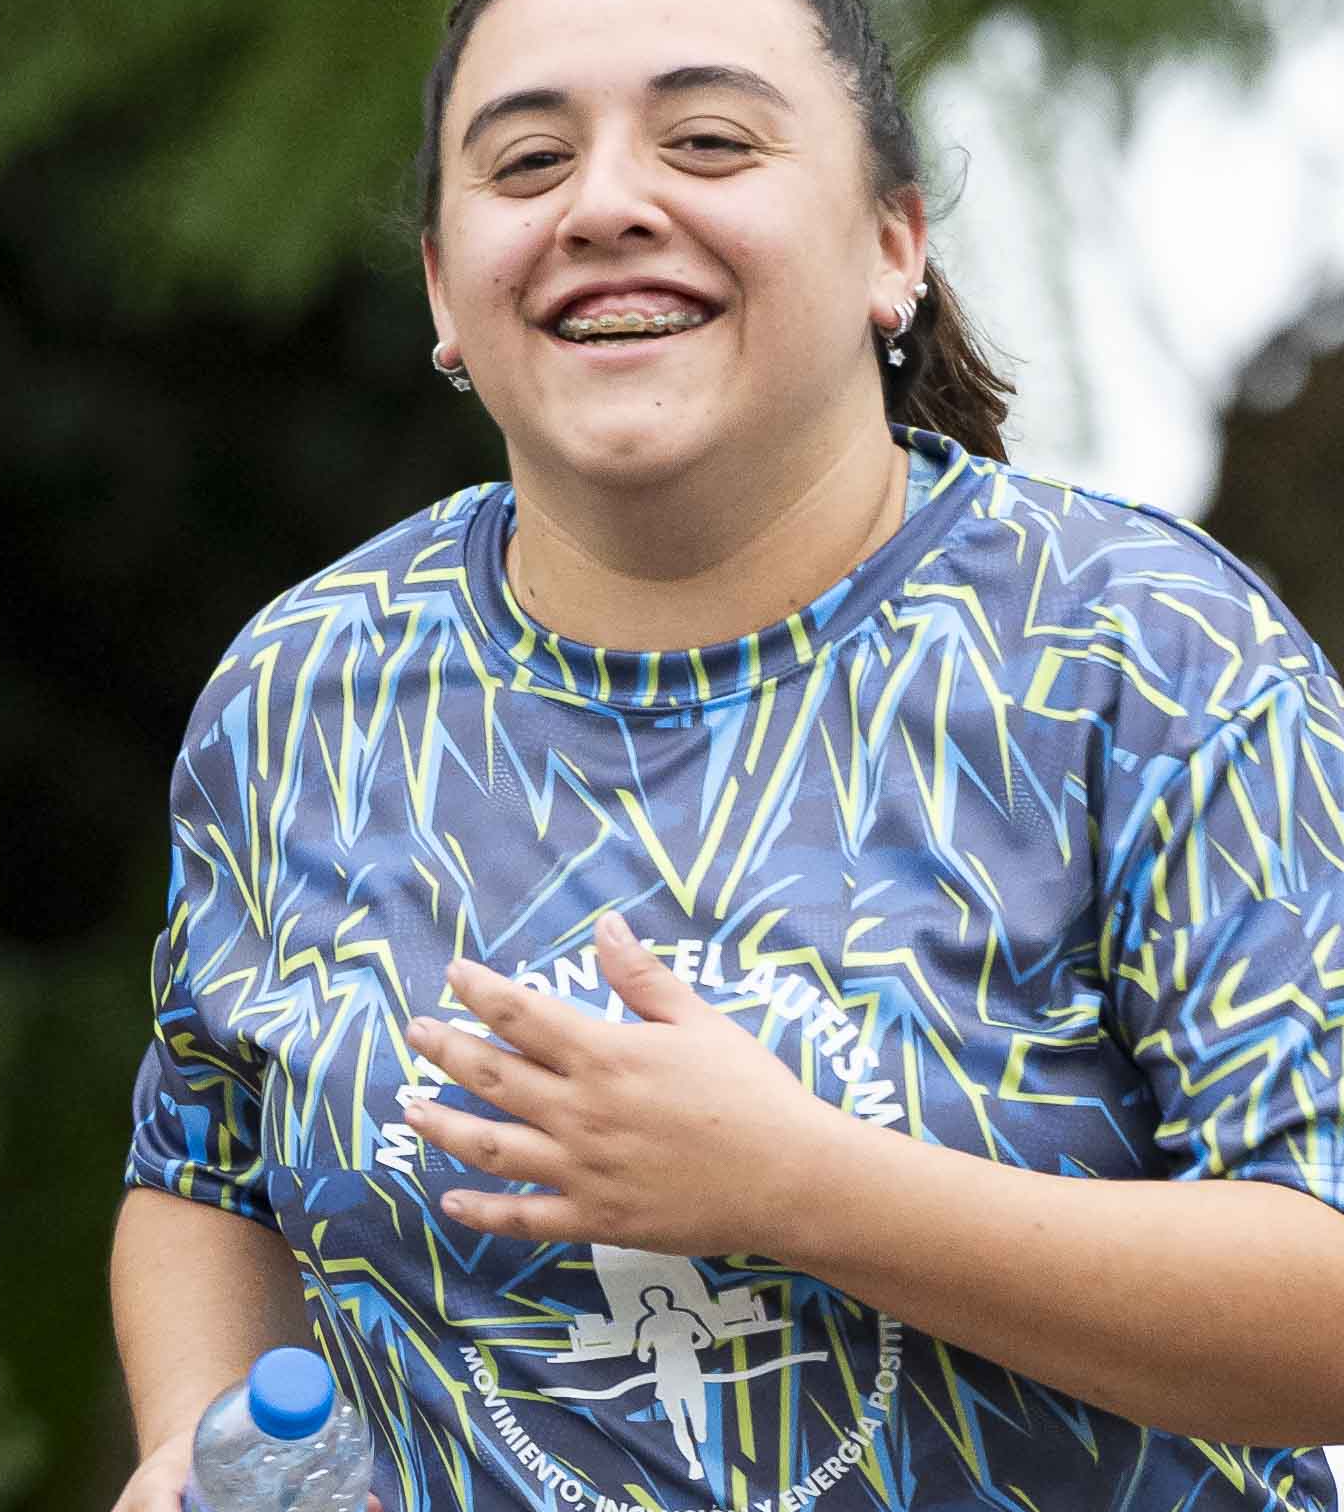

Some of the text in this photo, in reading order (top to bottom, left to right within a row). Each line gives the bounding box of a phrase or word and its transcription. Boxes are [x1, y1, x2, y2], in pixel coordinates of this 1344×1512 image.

[674, 938, 724, 987] EL
[736, 961, 905, 1128] AUTISM
[459, 1346, 587, 1512] MOVIMIENTO,
[867, 1312, 905, 1412] POSITI
